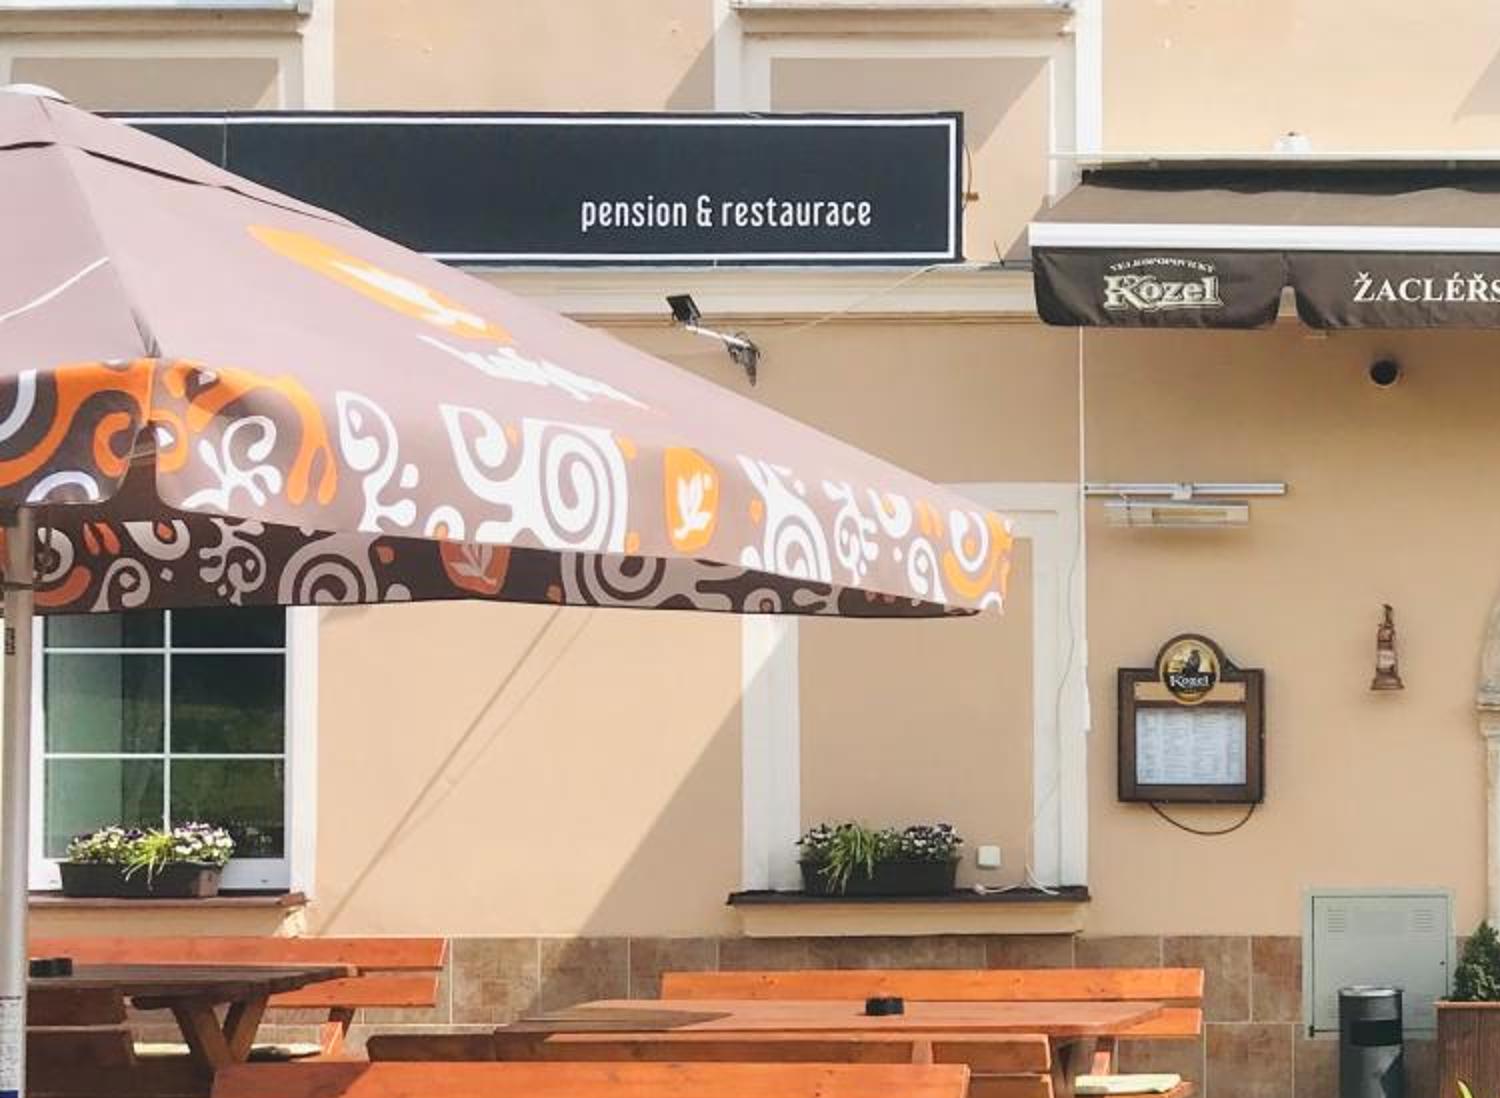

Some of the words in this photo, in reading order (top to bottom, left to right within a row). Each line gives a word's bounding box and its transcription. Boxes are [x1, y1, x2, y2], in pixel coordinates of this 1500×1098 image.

[581, 195, 687, 232] pension
[697, 195, 713, 227] &
[721, 197, 872, 227] restaurace
[1103, 274, 1224, 313] Kozel
[1169, 675, 1209, 689] Kozel
